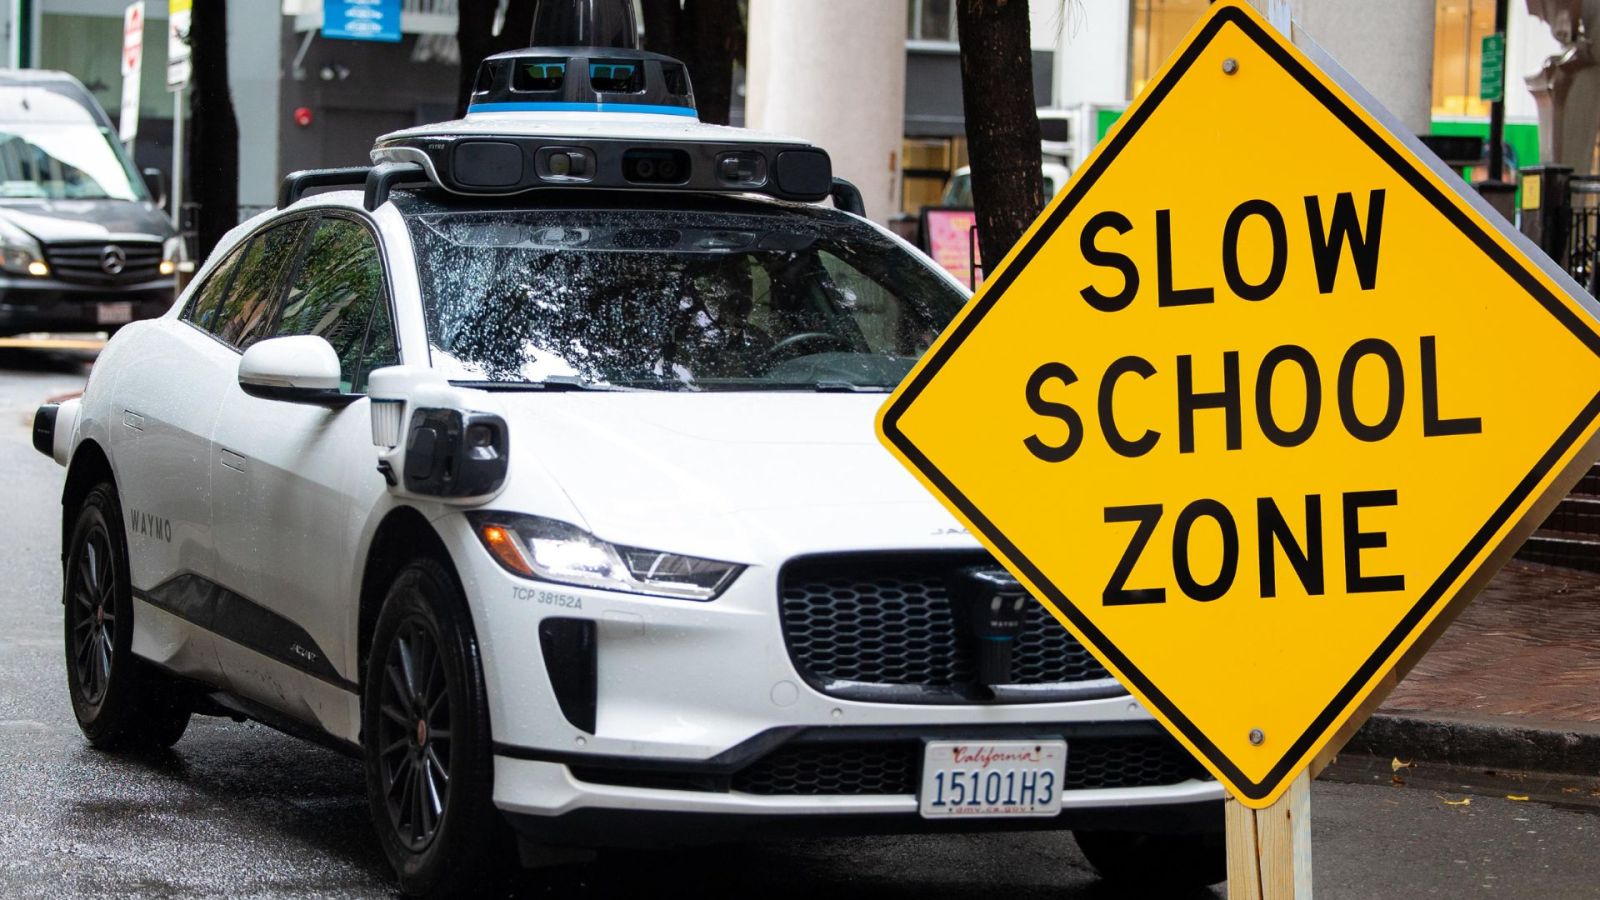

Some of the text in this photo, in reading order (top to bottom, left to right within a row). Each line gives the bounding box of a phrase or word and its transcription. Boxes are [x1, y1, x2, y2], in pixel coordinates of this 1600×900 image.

[1079, 188, 1386, 313] SLOW
[1023, 335, 1482, 463] SCHOOL
[130, 509, 171, 543] WAYMO
[1102, 489, 1406, 607] ZONE
[512, 586, 582, 610] TCP 38152A
[953, 746, 1040, 768] California
[932, 771, 1055, 806] 15101H3
